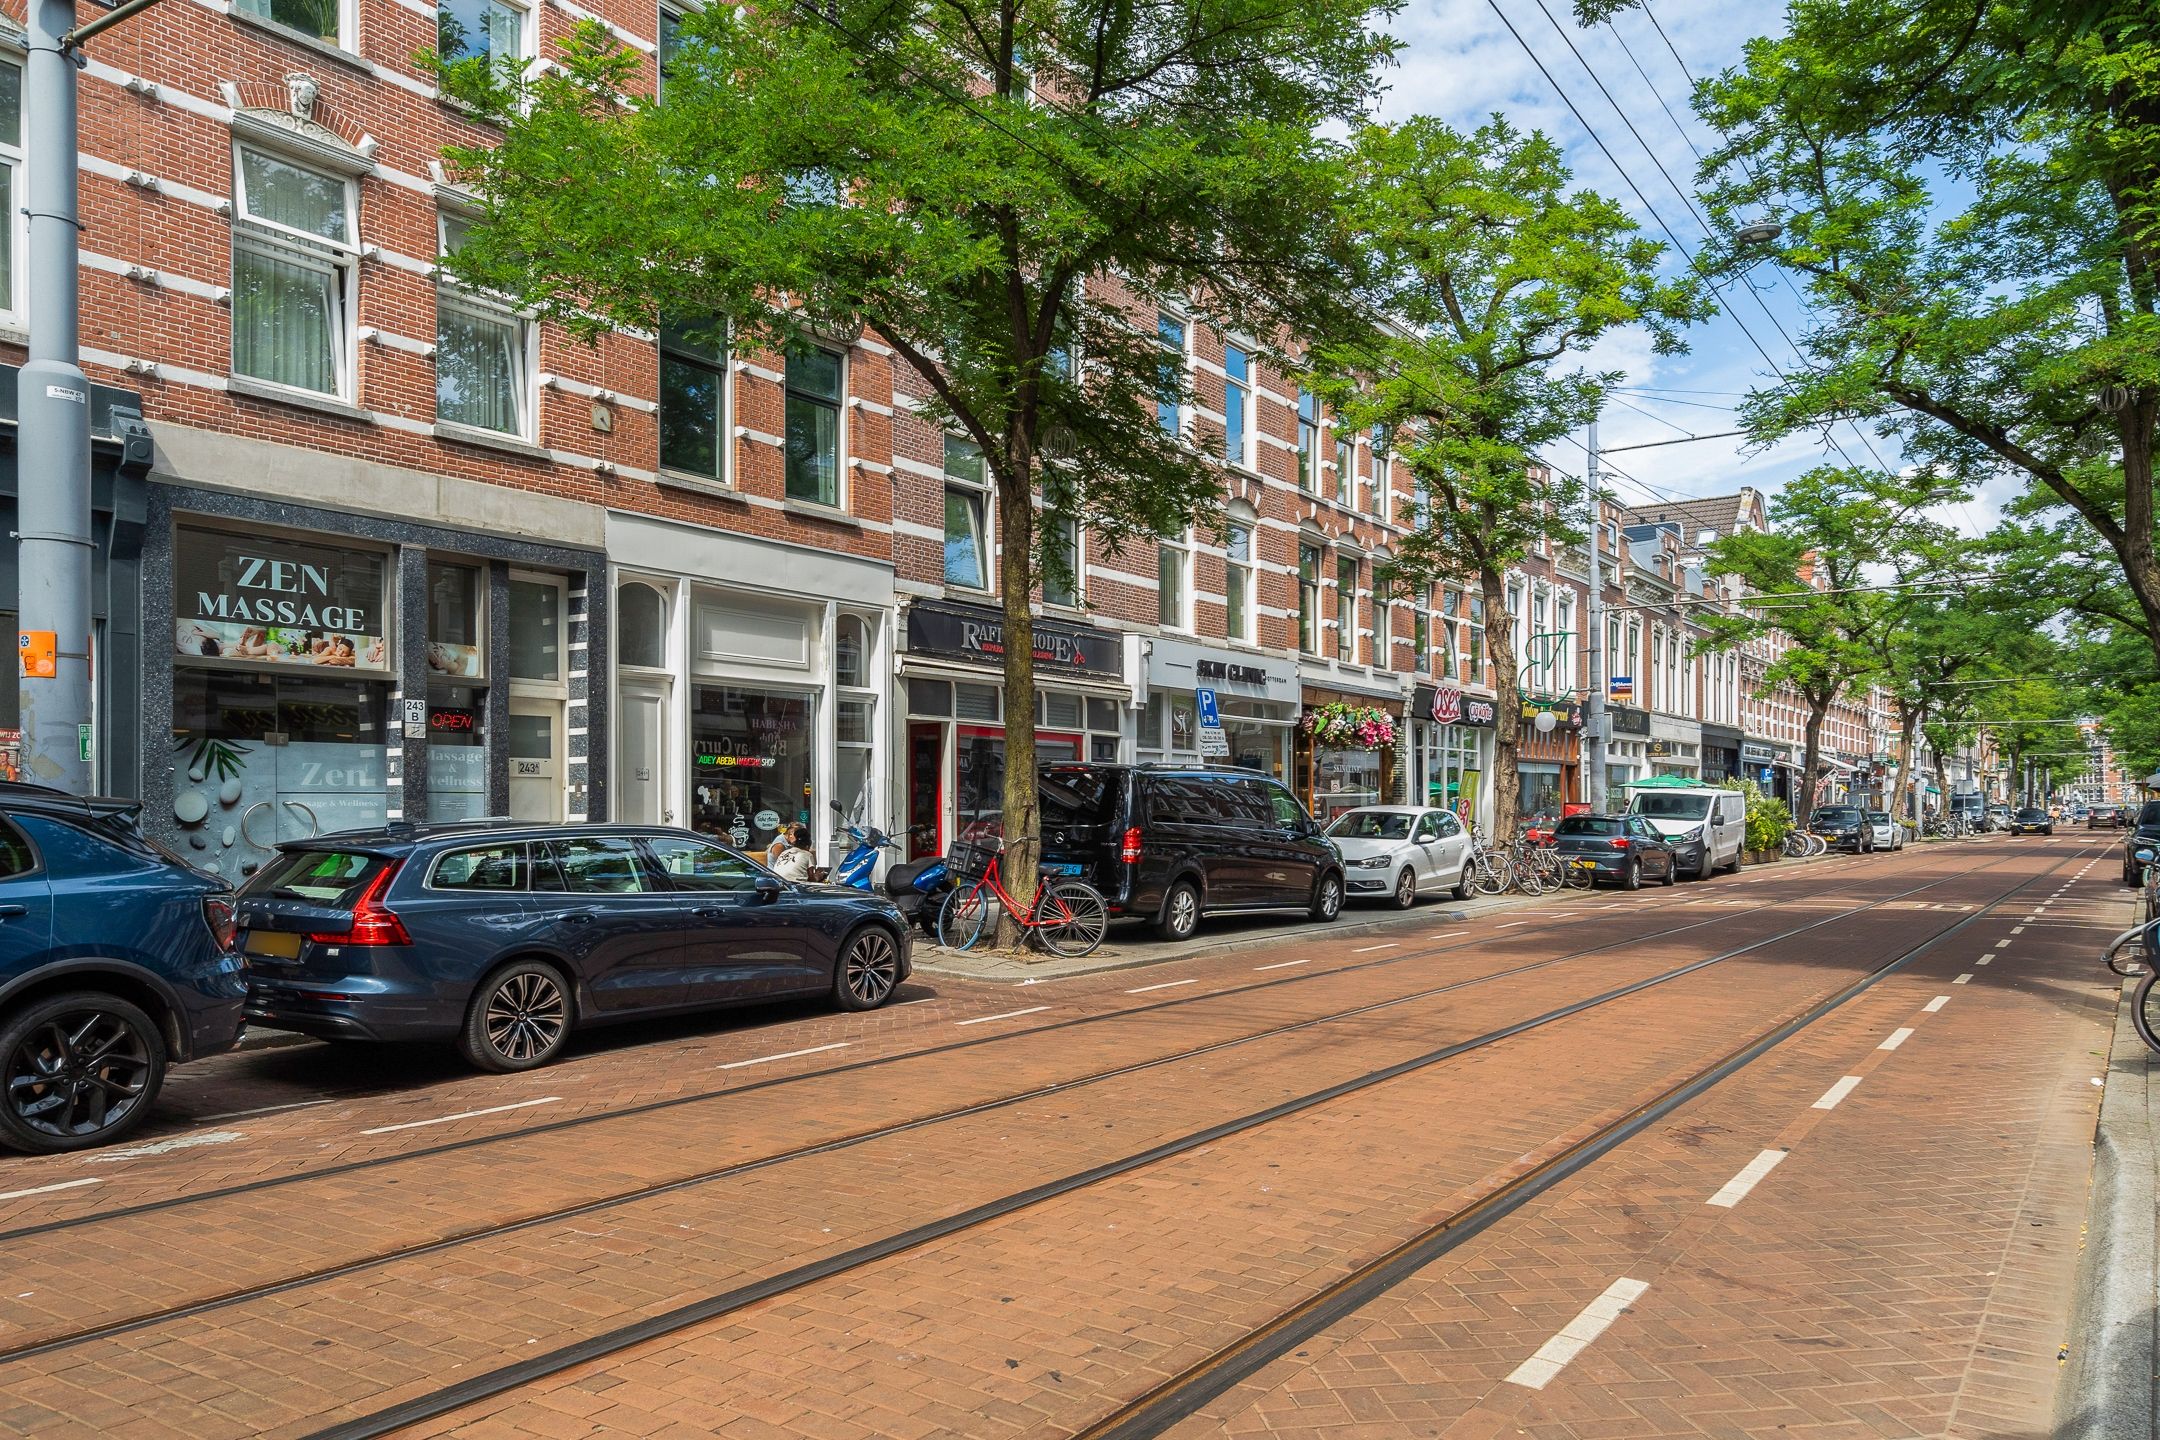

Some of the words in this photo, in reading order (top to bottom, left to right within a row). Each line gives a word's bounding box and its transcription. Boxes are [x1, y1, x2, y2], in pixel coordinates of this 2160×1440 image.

[237, 556, 328, 596] ZEN
[197, 591, 365, 631] MASSAGE
[406, 701, 424, 711] 243
[1201, 691, 1212, 711] P
[411, 712, 419, 721] B
[431, 713, 473, 728] OPEN
[698, 755, 716, 765] ADEY
[716, 756, 737, 766] ABEBA
[761, 757, 776, 767] SHOP
[300, 762, 370, 787] Zen
[1764, 768, 1771, 777] P
